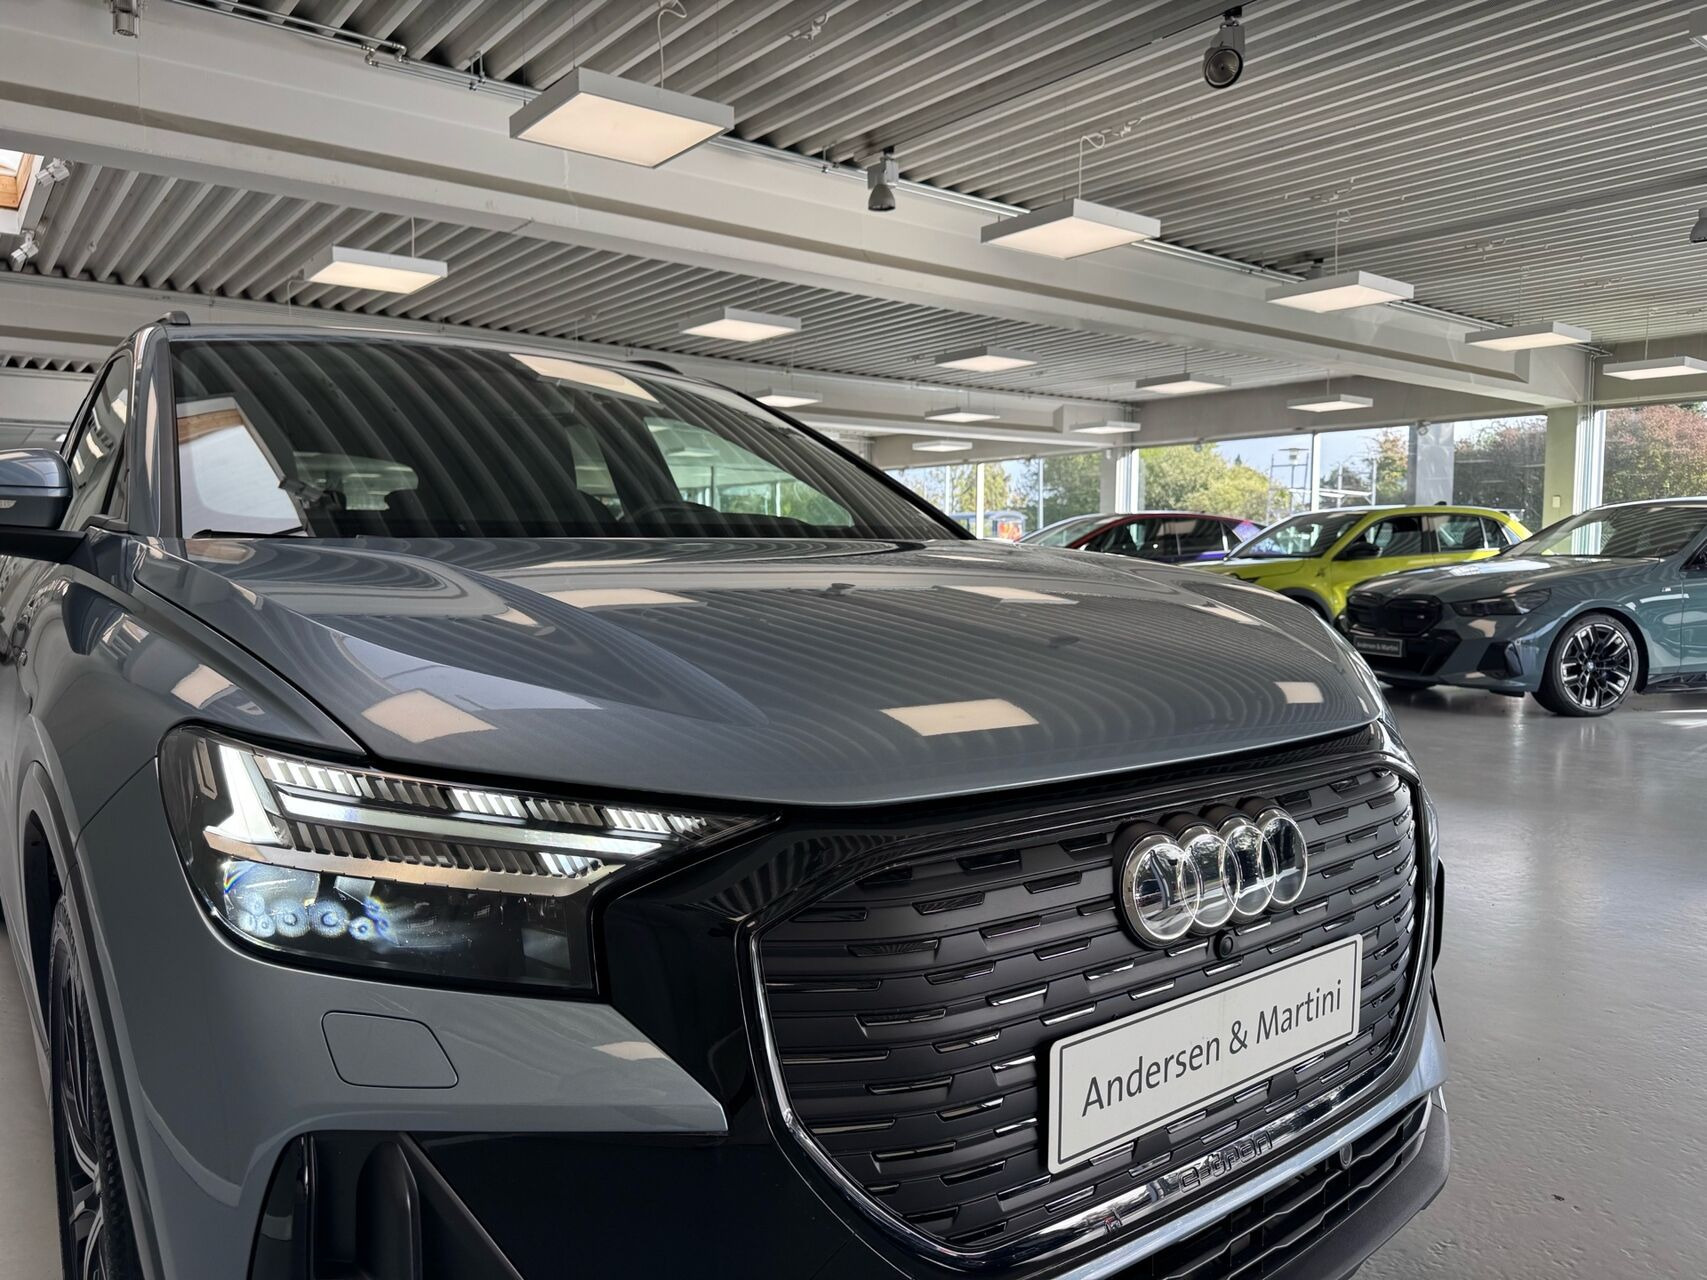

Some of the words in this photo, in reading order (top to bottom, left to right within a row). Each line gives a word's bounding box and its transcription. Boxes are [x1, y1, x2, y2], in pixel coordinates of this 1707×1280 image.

[1082, 1036, 1220, 1117] Andersen
[1228, 1020, 1248, 1055] &
[1256, 979, 1342, 1044] Martini
